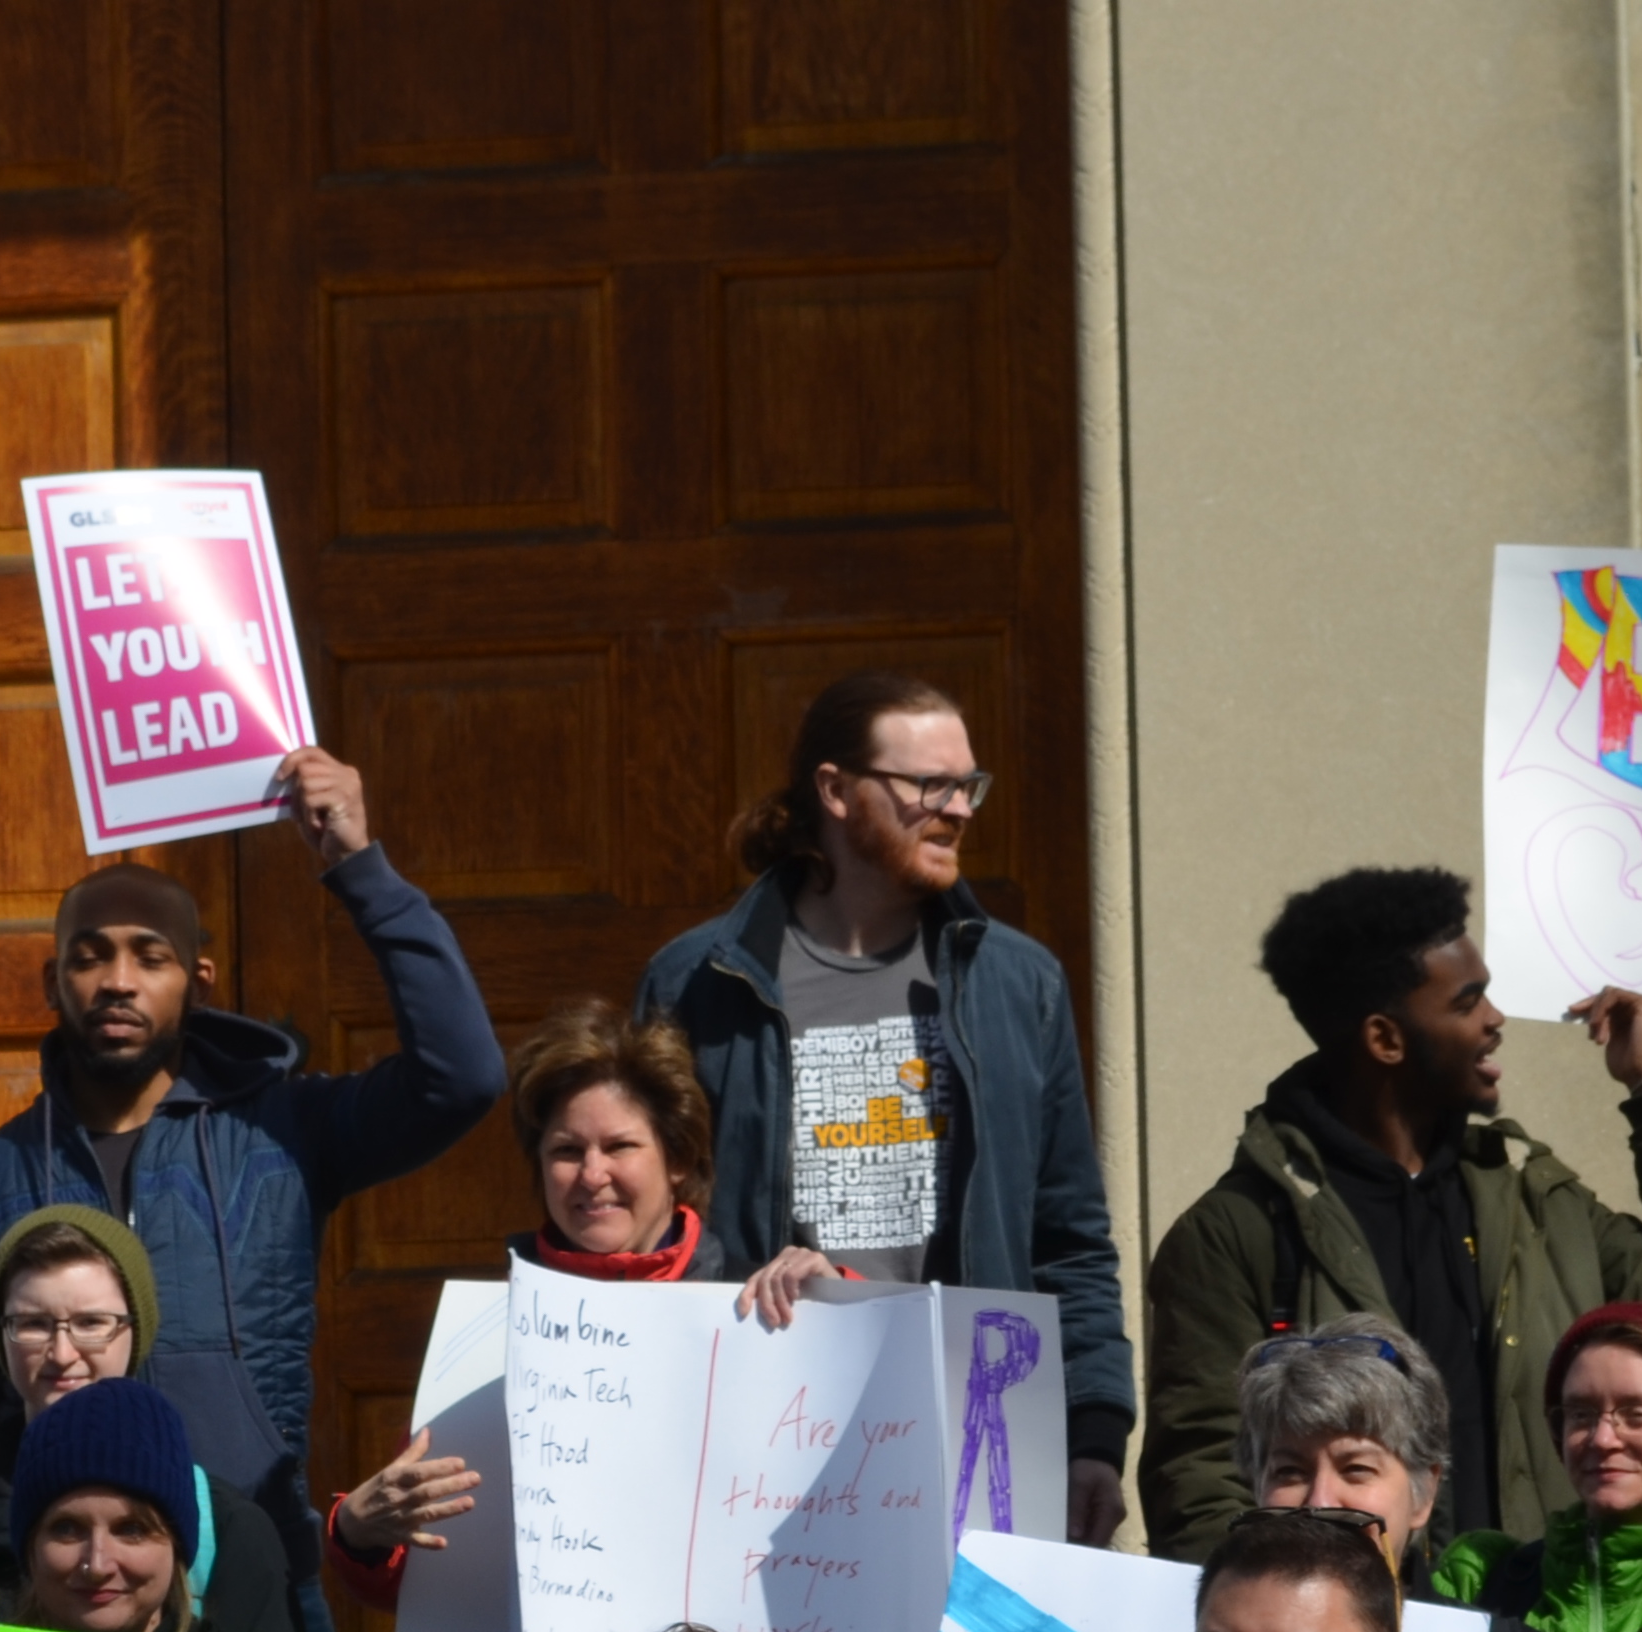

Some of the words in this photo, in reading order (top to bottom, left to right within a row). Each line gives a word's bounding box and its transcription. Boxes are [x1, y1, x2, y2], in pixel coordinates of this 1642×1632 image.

[101, 691, 239, 767] LEAD
[867, 1096, 901, 1123] BE
[819, 1233, 924, 1251] TRANSGENDER
[583, 1368, 632, 1409] Tech
[769, 1385, 836, 1451] Are
[860, 1418, 917, 1498] your
[723, 1472, 859, 1534] thoughts
[880, 1486, 922, 1511] and
